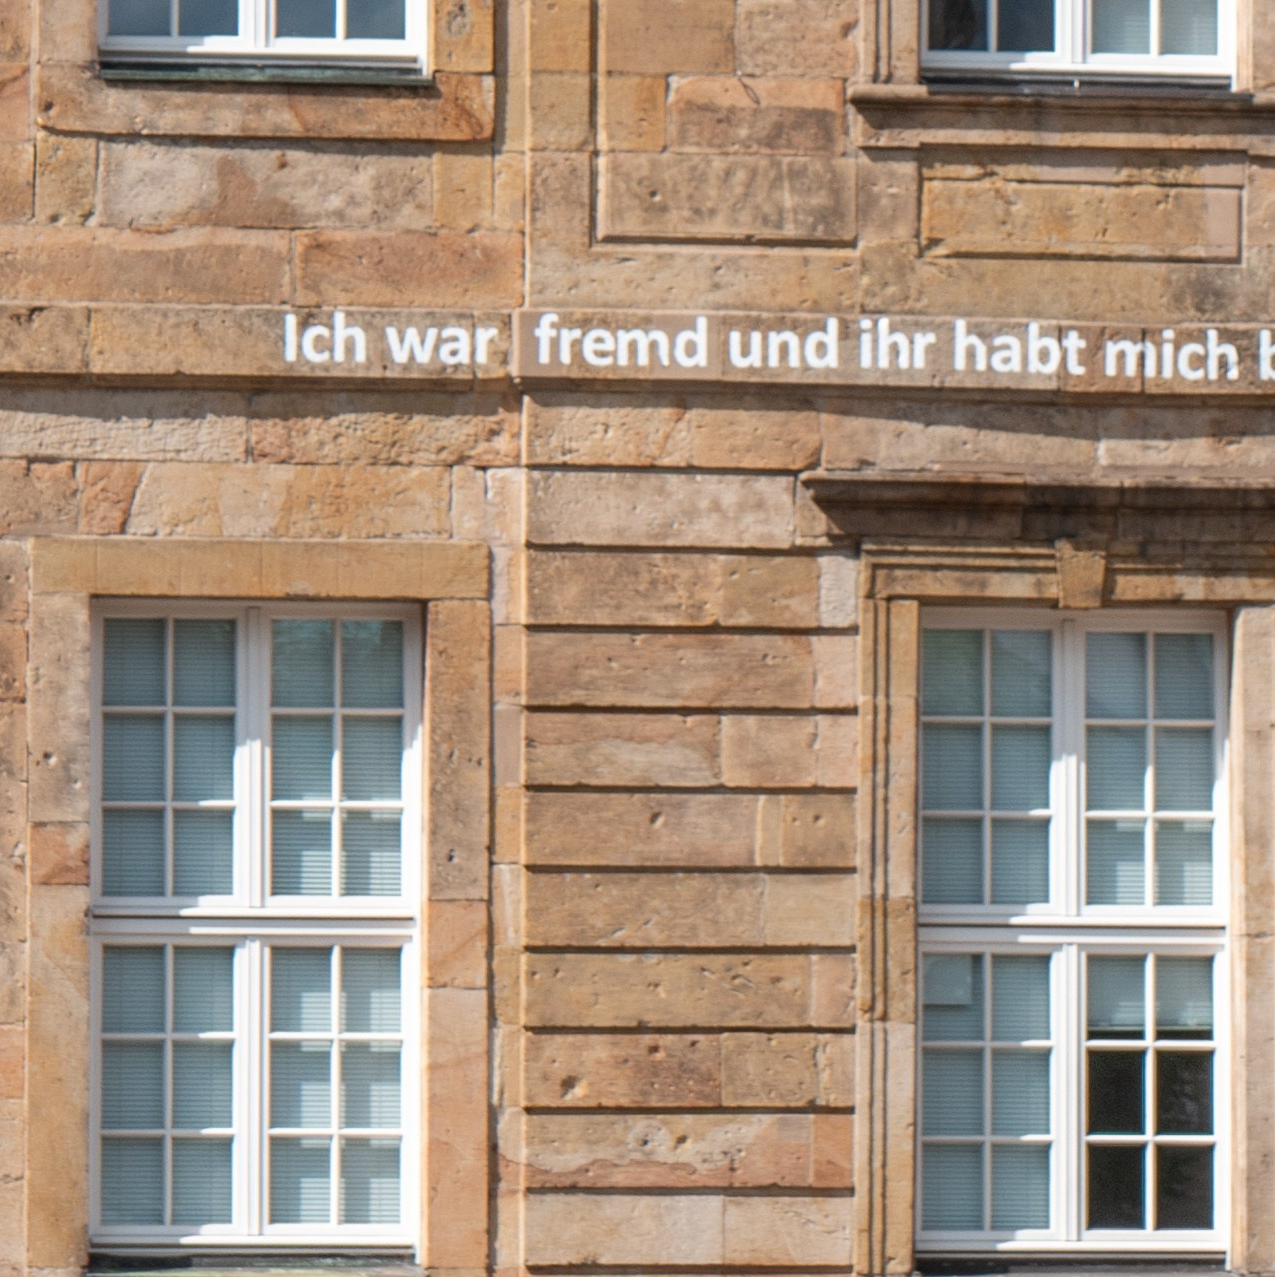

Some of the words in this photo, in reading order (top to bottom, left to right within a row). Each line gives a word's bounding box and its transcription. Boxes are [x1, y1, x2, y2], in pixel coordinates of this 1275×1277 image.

[283, 311, 367, 364] Ich
[384, 325, 499, 365] war
[535, 312, 708, 368] fremd
[729, 316, 838, 370] und
[859, 317, 936, 370] ihr
[953, 318, 1087, 376] habt
[1103, 328, 1240, 381] mich
